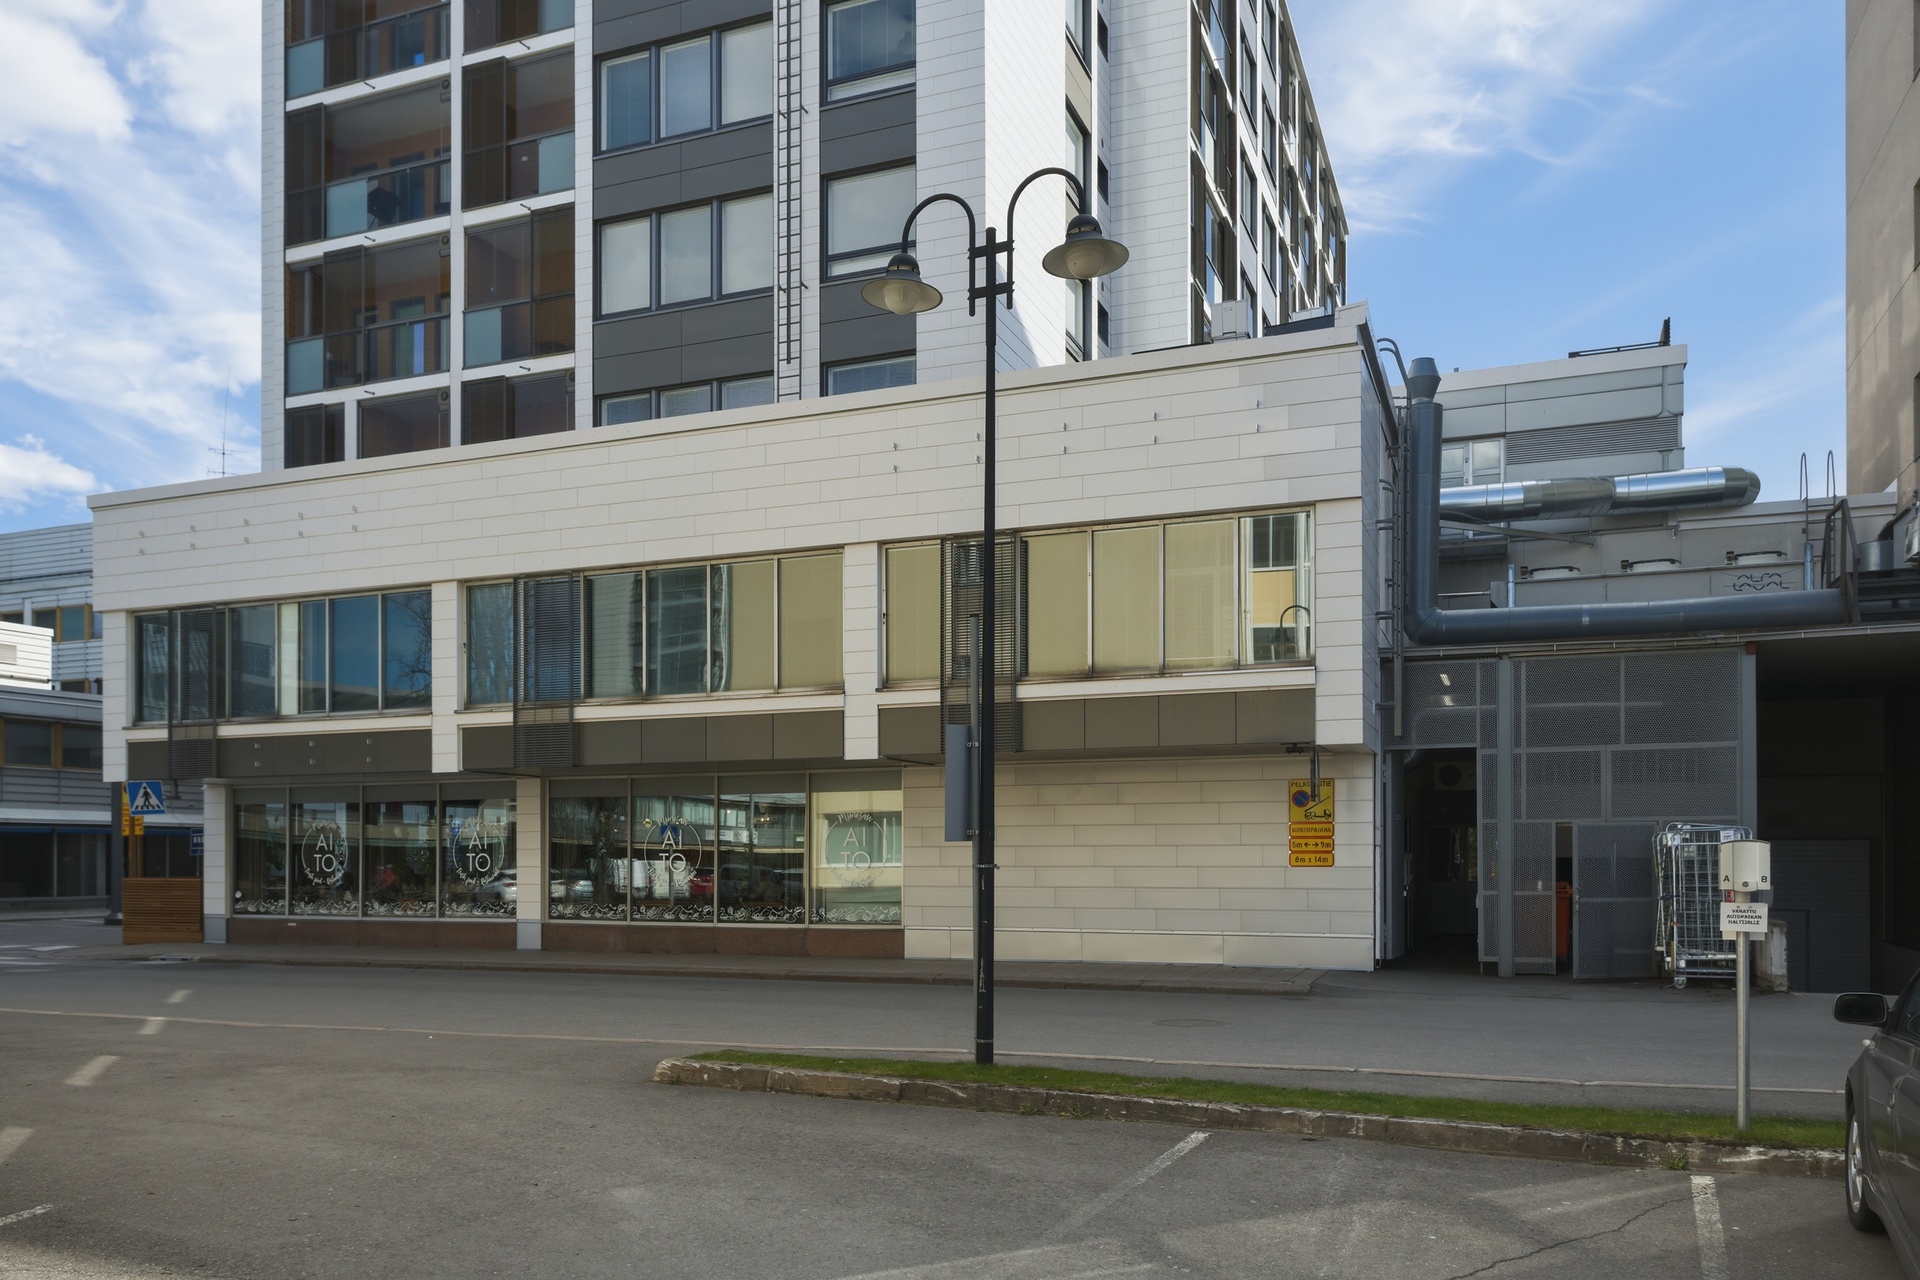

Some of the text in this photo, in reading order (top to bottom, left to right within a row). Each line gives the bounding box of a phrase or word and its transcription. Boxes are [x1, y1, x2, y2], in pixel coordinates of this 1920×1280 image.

[1290, 780, 1332, 788] PELASSTIE
[315, 833, 333, 851] AI
[469, 831, 487, 850] AI
[661, 829, 682, 849] AI
[313, 854, 336, 872] TO
[466, 853, 491, 872] TO
[659, 853, 686, 873] TO
